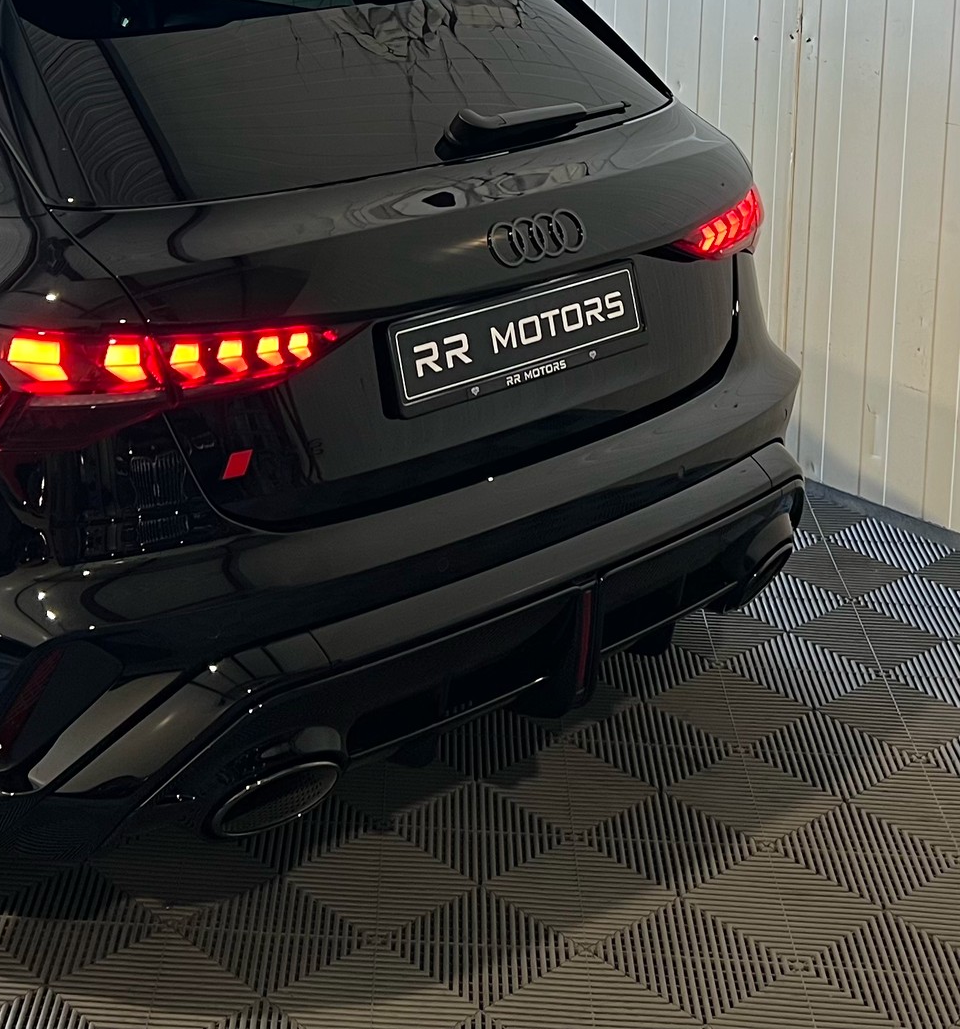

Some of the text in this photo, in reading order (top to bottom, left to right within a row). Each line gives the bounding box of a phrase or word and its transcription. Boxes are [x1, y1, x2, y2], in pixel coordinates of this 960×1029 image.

[413, 291, 625, 378] RR MOTORS
[506, 359, 567, 387] RR MOTORS
